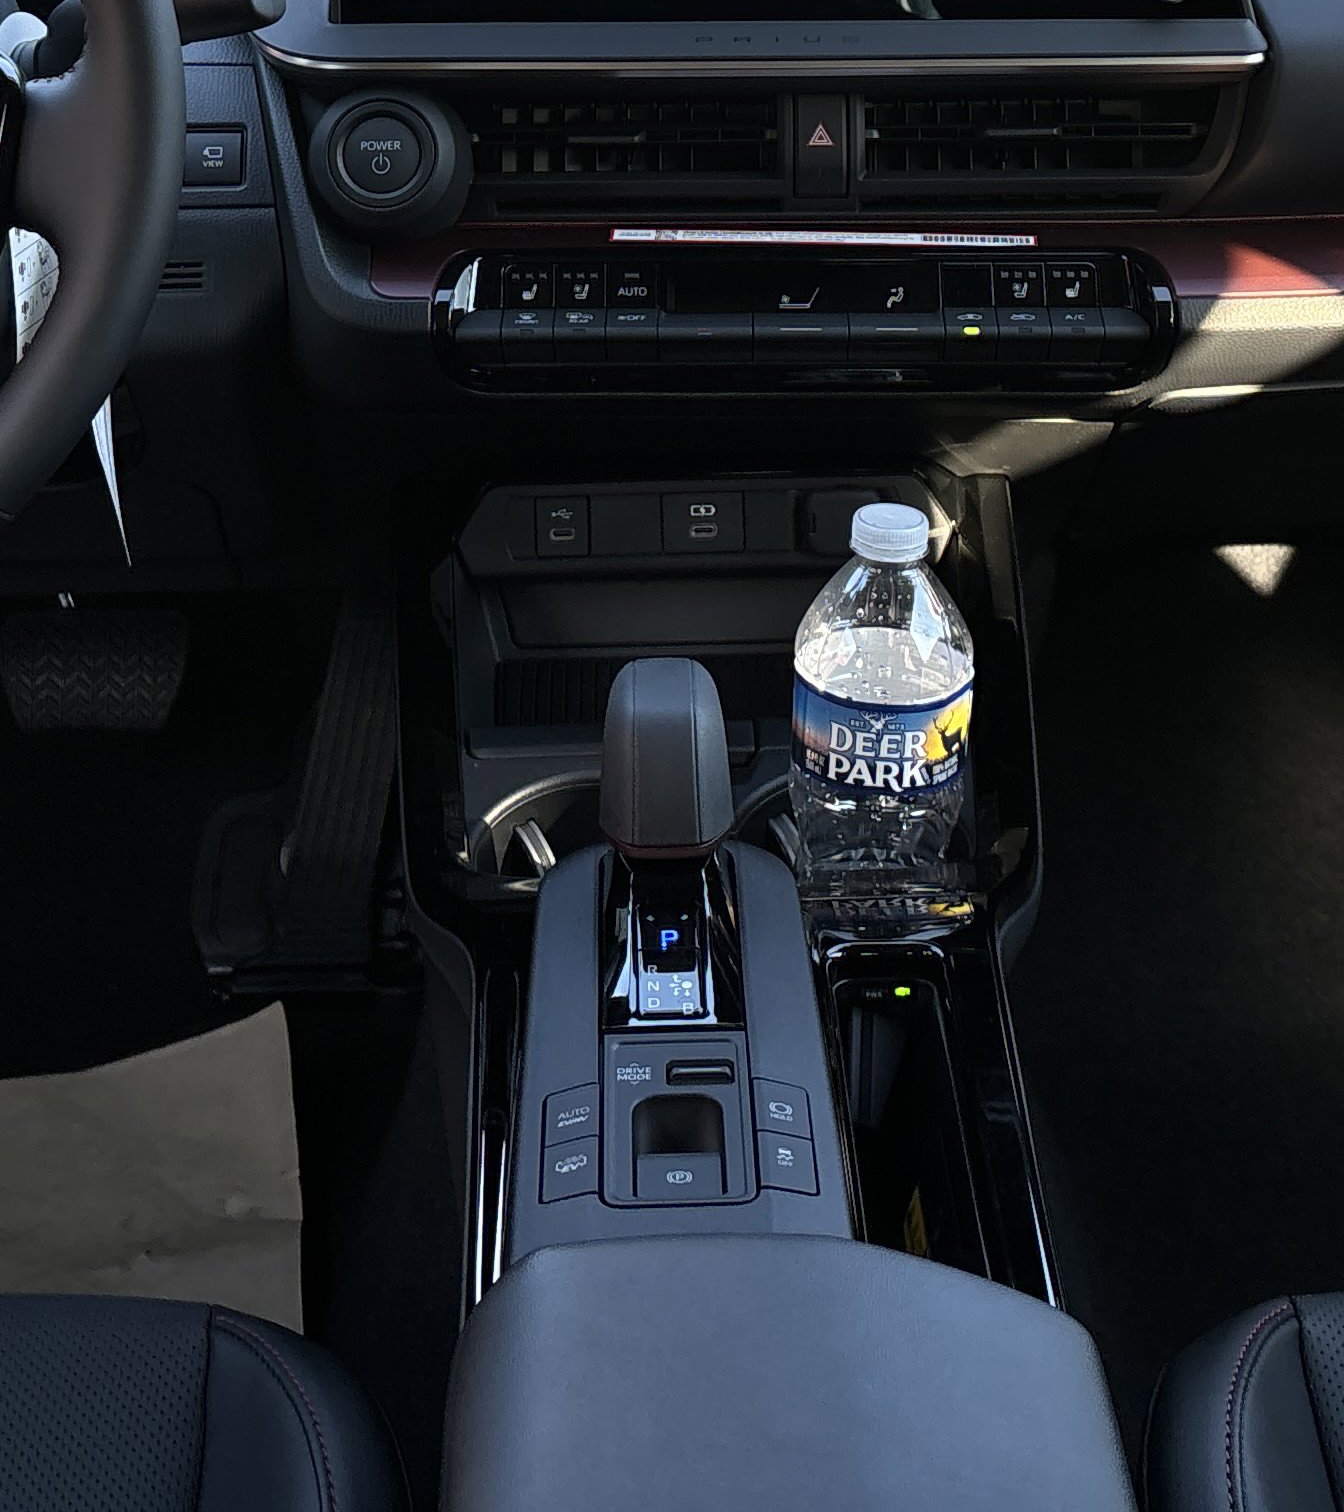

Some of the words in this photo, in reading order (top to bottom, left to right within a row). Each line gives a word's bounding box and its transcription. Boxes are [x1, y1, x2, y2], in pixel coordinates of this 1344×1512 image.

[359, 140, 402, 151] POWER
[201, 159, 224, 168] VIEW
[617, 287, 648, 297] AUTO
[1065, 313, 1086, 321] A/C
[829, 720, 929, 759] DEER
[826, 751, 928, 792] PARK
[660, 929, 678, 945] P
[647, 964, 658, 974] R
[647, 980, 660, 991] N
[647, 997, 660, 1008] D
[682, 1002, 694, 1014] B
[617, 1067, 652, 1075] DRIVE
[617, 1073, 652, 1081] MODE
[557, 1105, 591, 1120] AUTO
